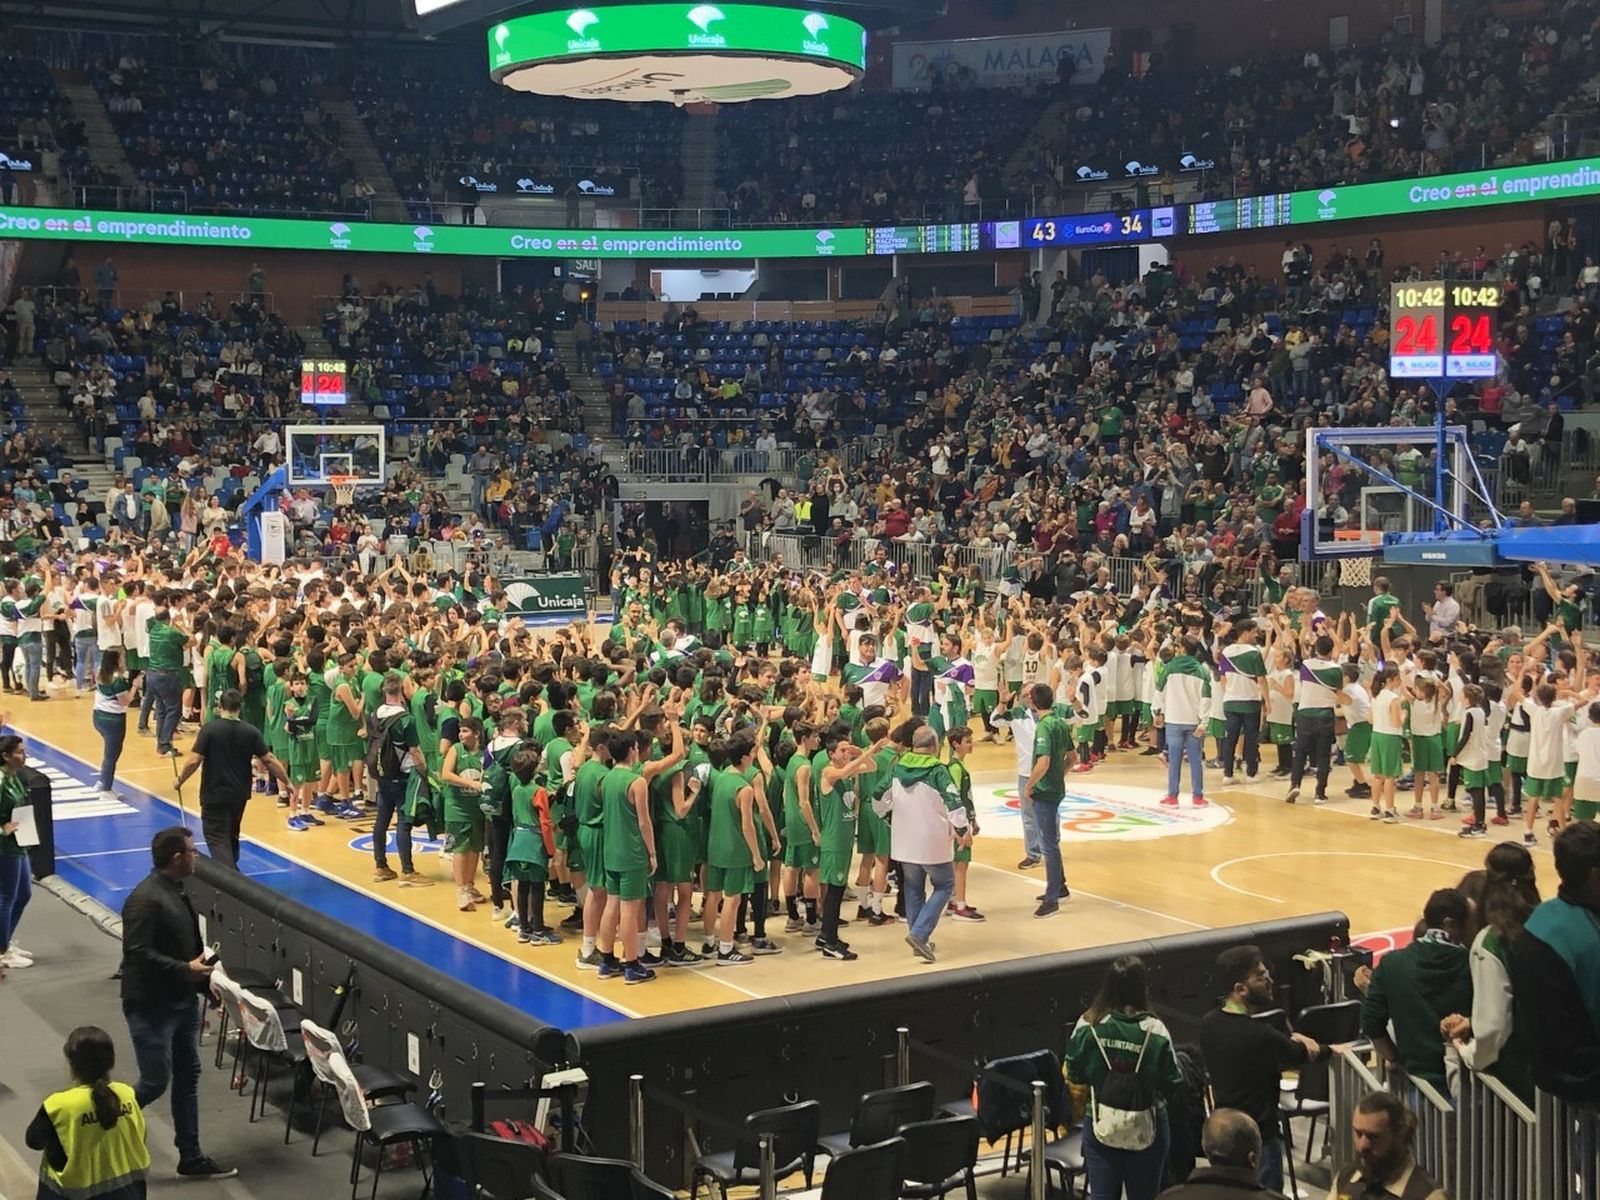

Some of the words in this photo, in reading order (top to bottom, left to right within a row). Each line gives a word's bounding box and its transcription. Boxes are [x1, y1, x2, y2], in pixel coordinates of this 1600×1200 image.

[688, 33, 725, 45] Unicaja
[1410, 185, 1449, 202] Creo
[1454, 184, 1476, 198] en
[1480, 176, 1498, 196] el
[45, 218, 68, 231] en
[72, 216, 92, 232] el
[97, 220, 251, 239] emprendimiento
[1032, 222, 1056, 241] 43
[1075, 224, 1104, 235] EuroCup
[1121, 214, 1142, 234] 34
[510, 234, 552, 249] Creo
[556, 239, 577, 250] en
[581, 236, 598, 250] el
[602, 236, 742, 255] emprendimiento
[1396, 288, 1444, 307] 10:42
[1451, 287, 1498, 306] 10:42
[1395, 315, 1438, 355] 24
[1451, 314, 1493, 354] 24
[317, 362, 346, 373] 10:42
[318, 375, 342, 394] 24
[537, 593, 584, 609] Unicaja
[1025, 660, 1038, 673] 10
